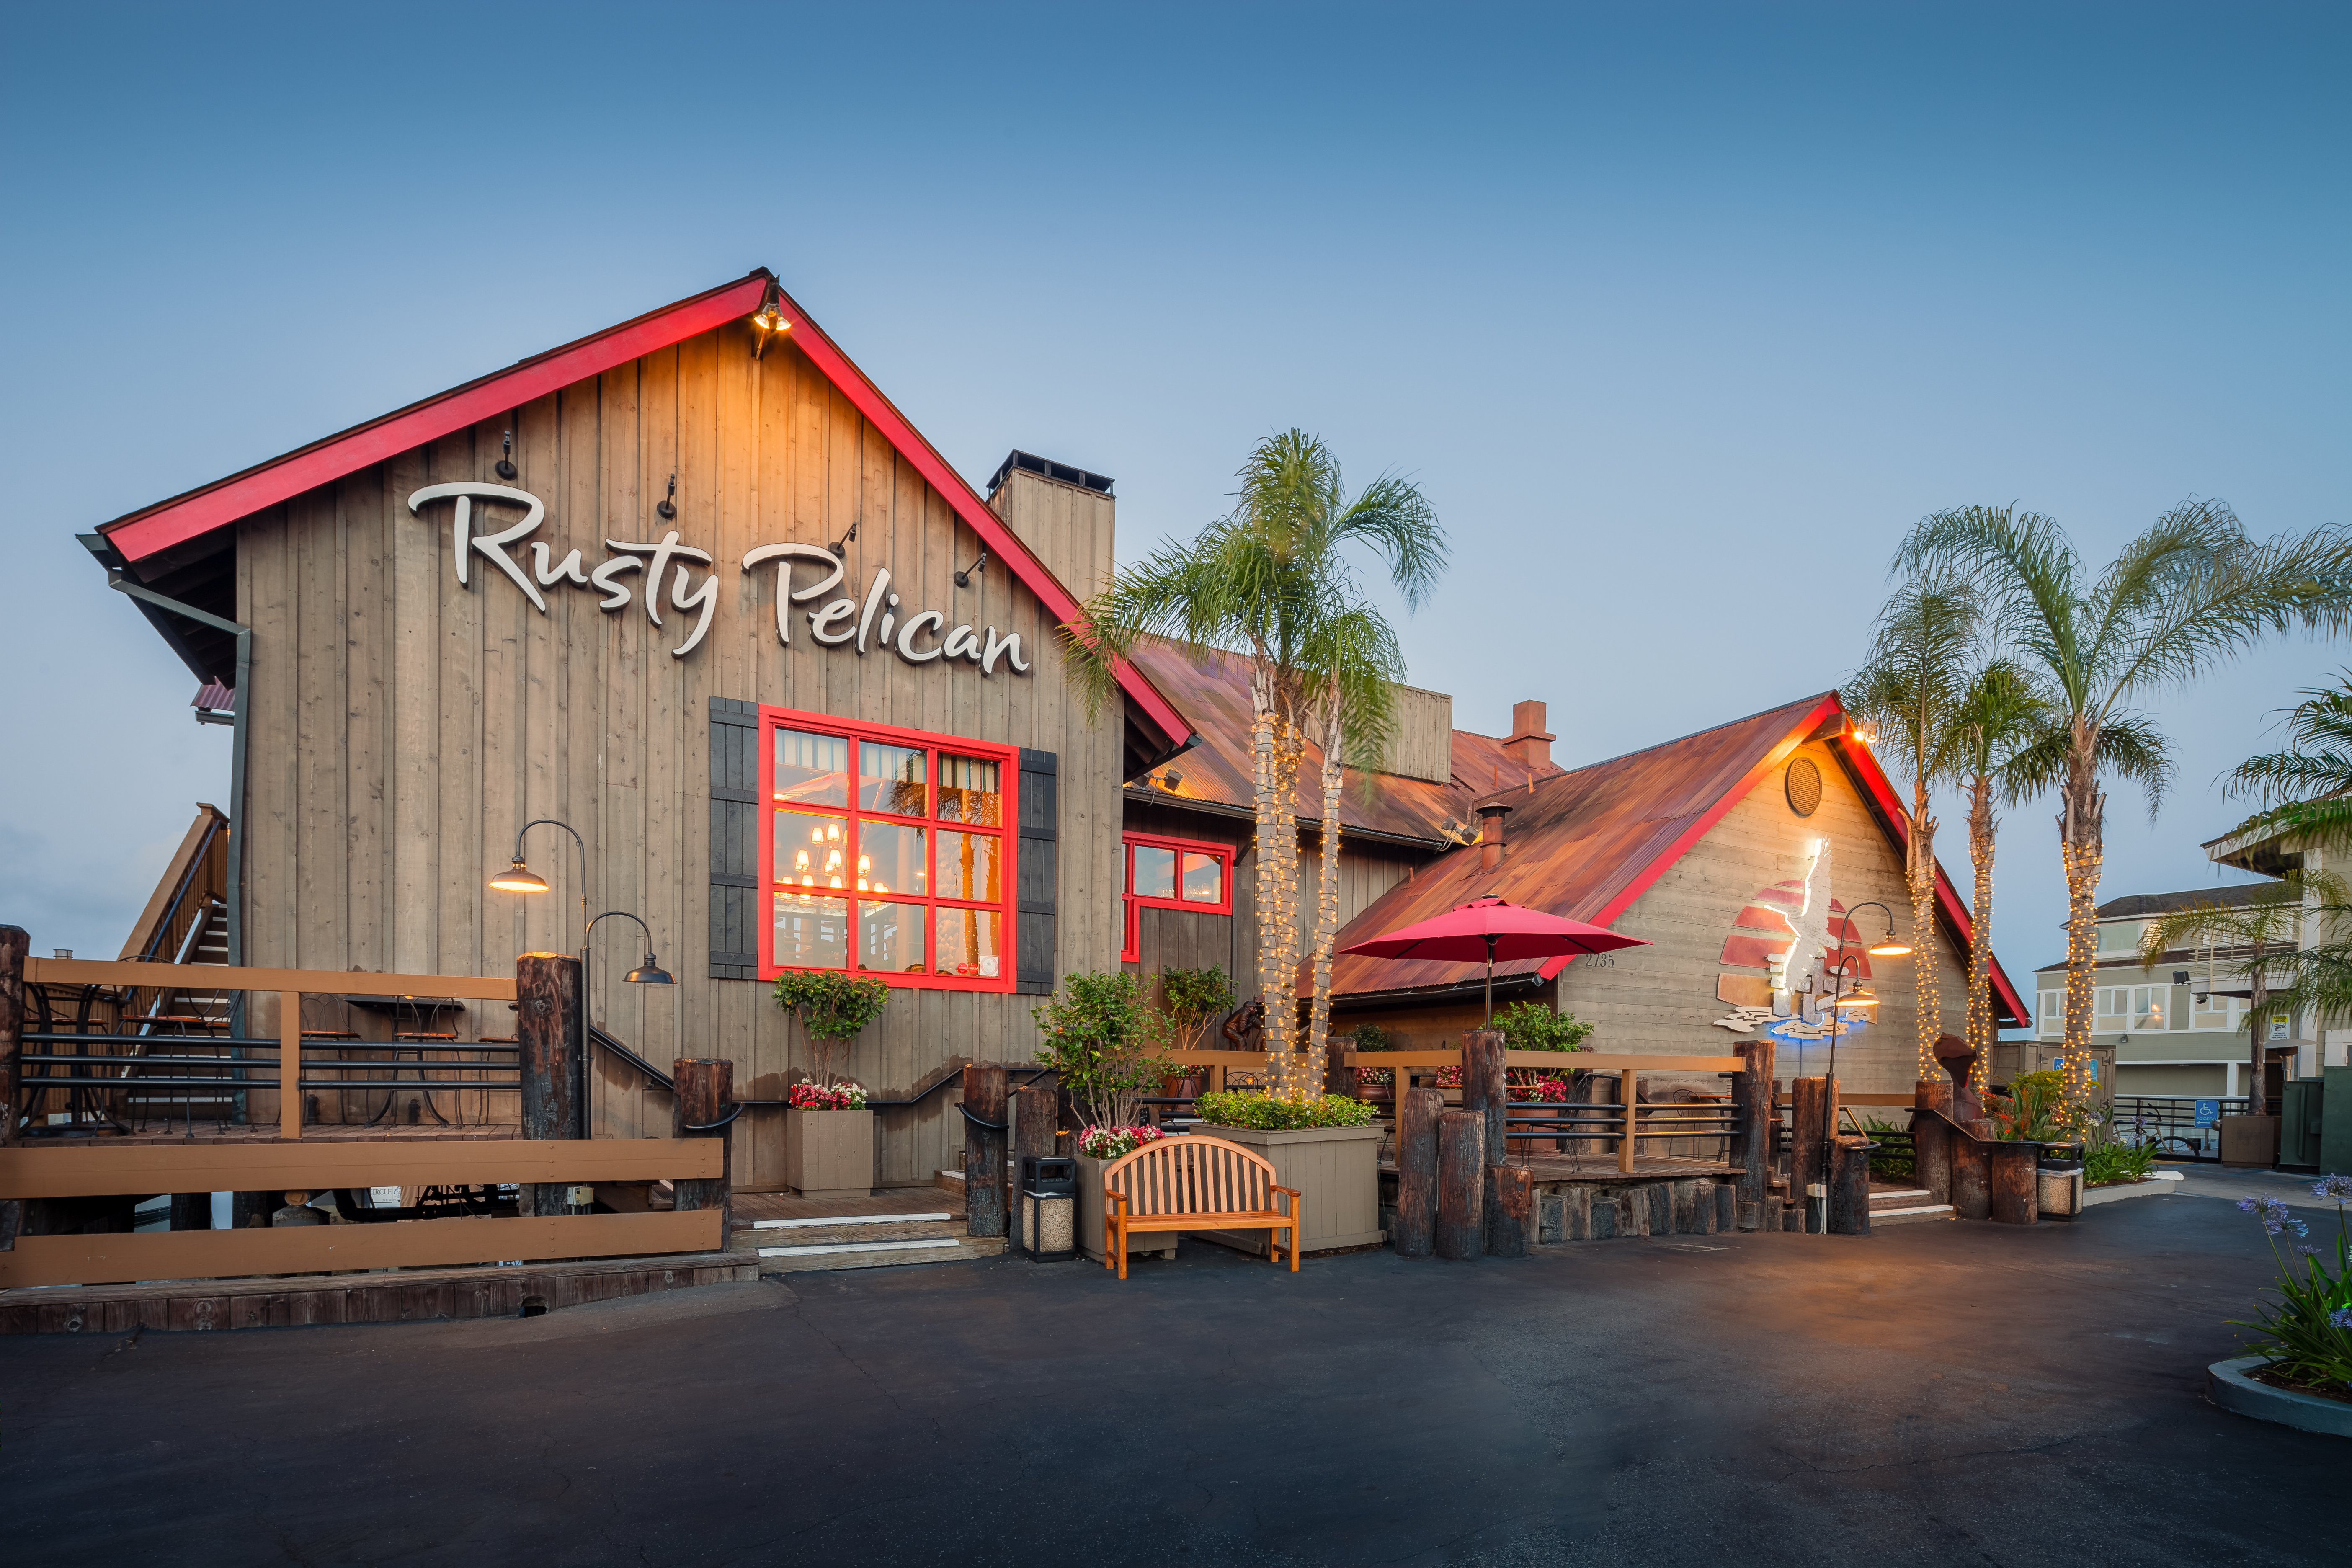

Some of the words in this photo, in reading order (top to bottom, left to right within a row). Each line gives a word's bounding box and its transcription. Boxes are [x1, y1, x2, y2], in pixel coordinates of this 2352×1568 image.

[407, 482, 718, 658] Rusty
[741, 542, 1029, 676] Pelican
[1586, 953, 1614, 967] 2735
